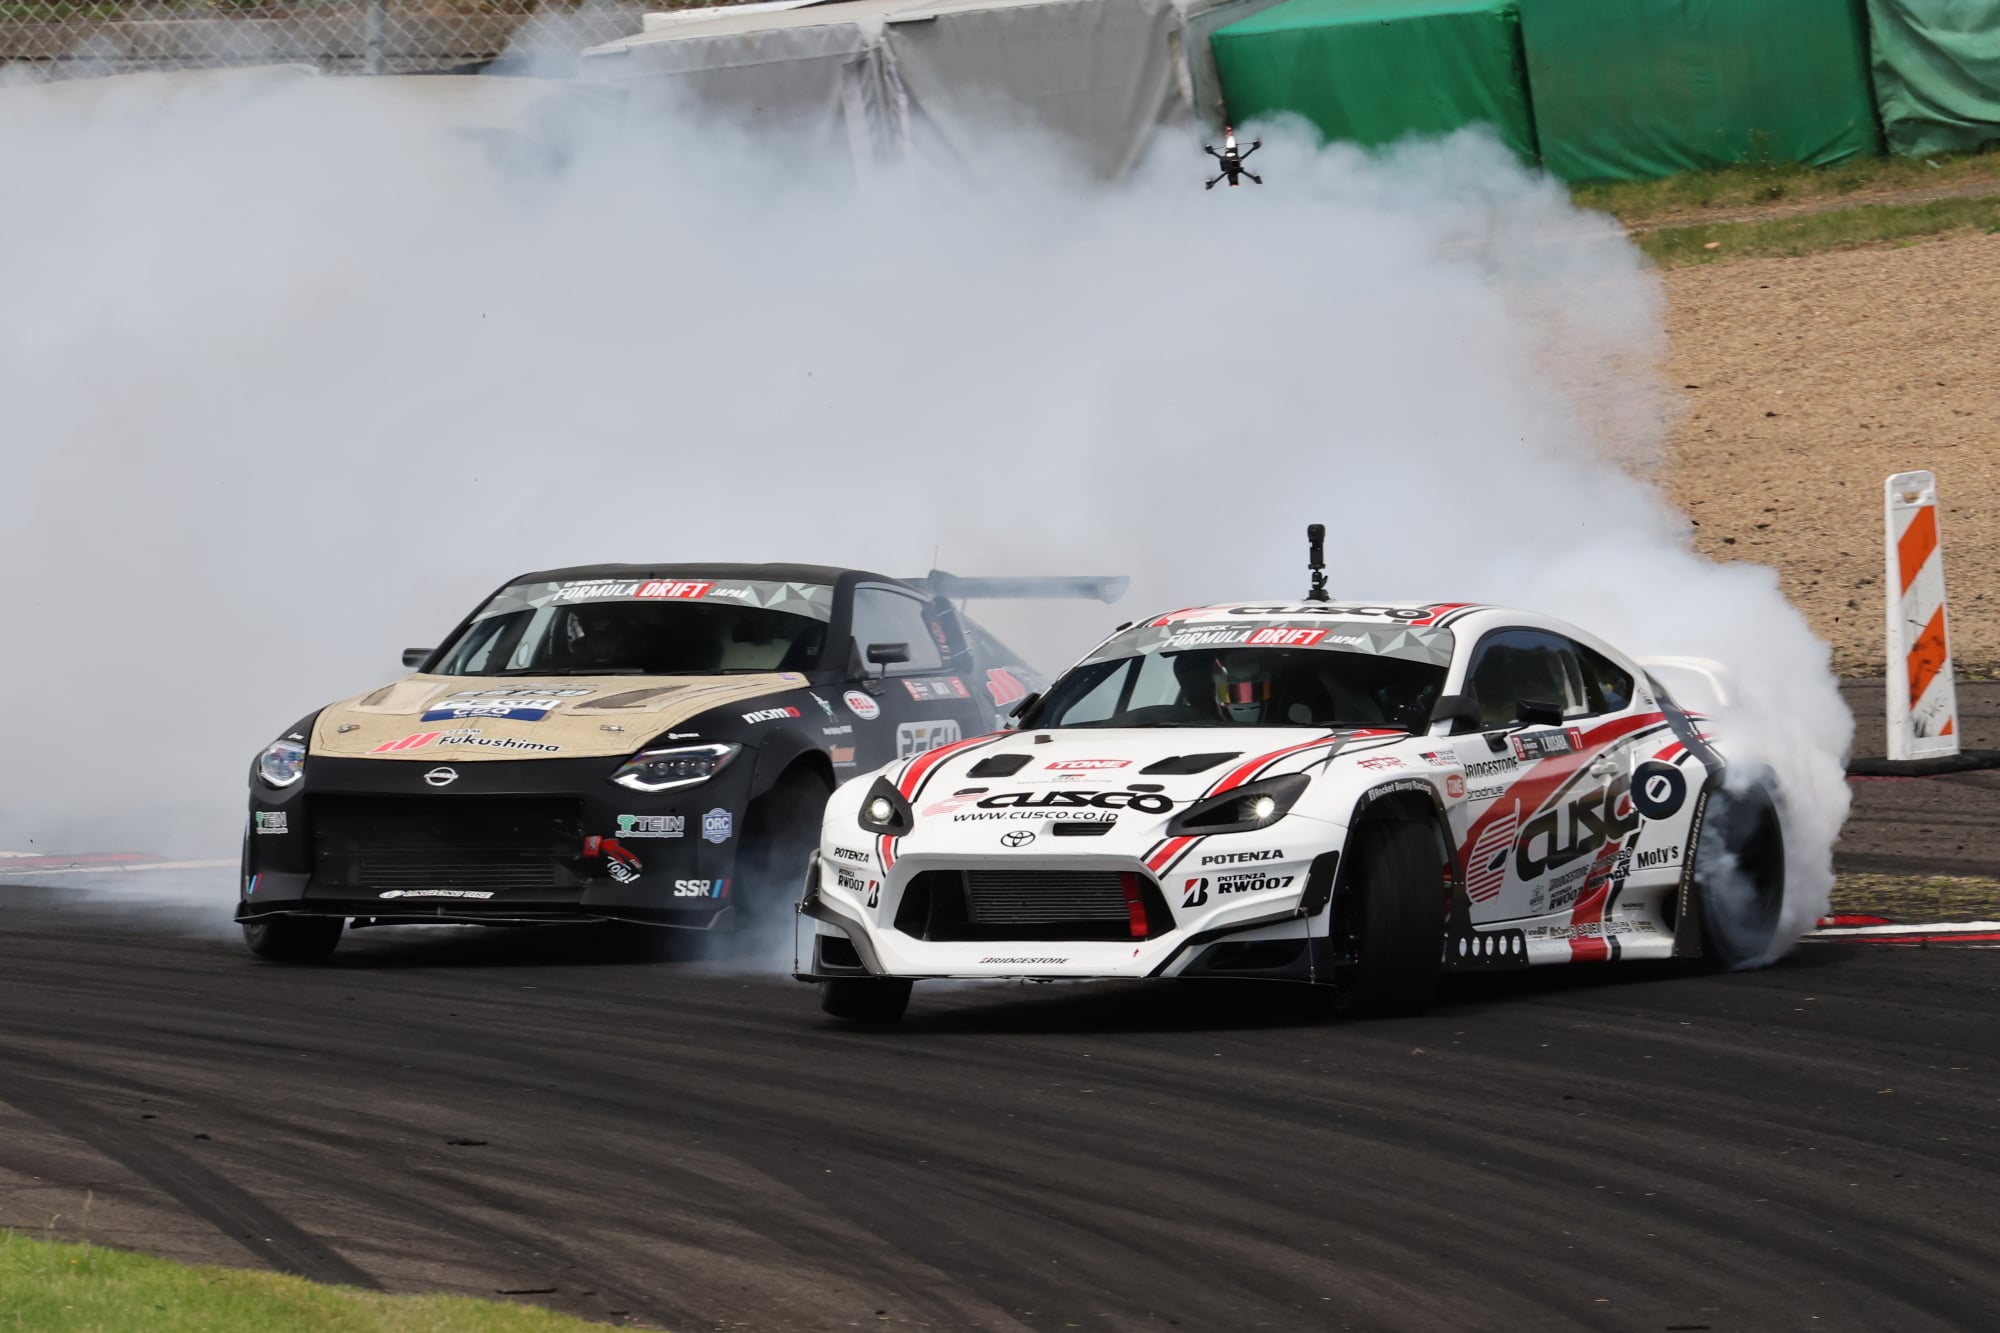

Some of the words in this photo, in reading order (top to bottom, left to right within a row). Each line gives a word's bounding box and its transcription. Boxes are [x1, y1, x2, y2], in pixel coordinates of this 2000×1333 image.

[552, 583, 639, 601] FORMULA
[640, 582, 710, 598] DRIFT
[708, 588, 750, 599] JAPAN
[1229, 605, 1433, 619] CUSCO
[1162, 630, 1250, 648] FORMULA
[1251, 628, 1327, 645] DRIFT
[1323, 635, 1367, 646] JAPAN
[438, 734, 562, 752] Fukushima
[1055, 760, 1128, 769] TONE
[1375, 783, 1396, 798] Rocket
[977, 791, 1174, 815] CUSCO
[636, 816, 685, 831] TEIN
[706, 818, 729, 831] ORC
[953, 811, 1119, 823] www.cusco.co.jp
[834, 847, 869, 863] POTENZA
[1201, 849, 1285, 866] POTENZA
[1637, 845, 1680, 868] Moty's
[838, 875, 865, 892] RW007
[1217, 872, 1267, 882] POTENZA
[1218, 876, 1295, 894] RW007
[674, 880, 710, 897] SSR
